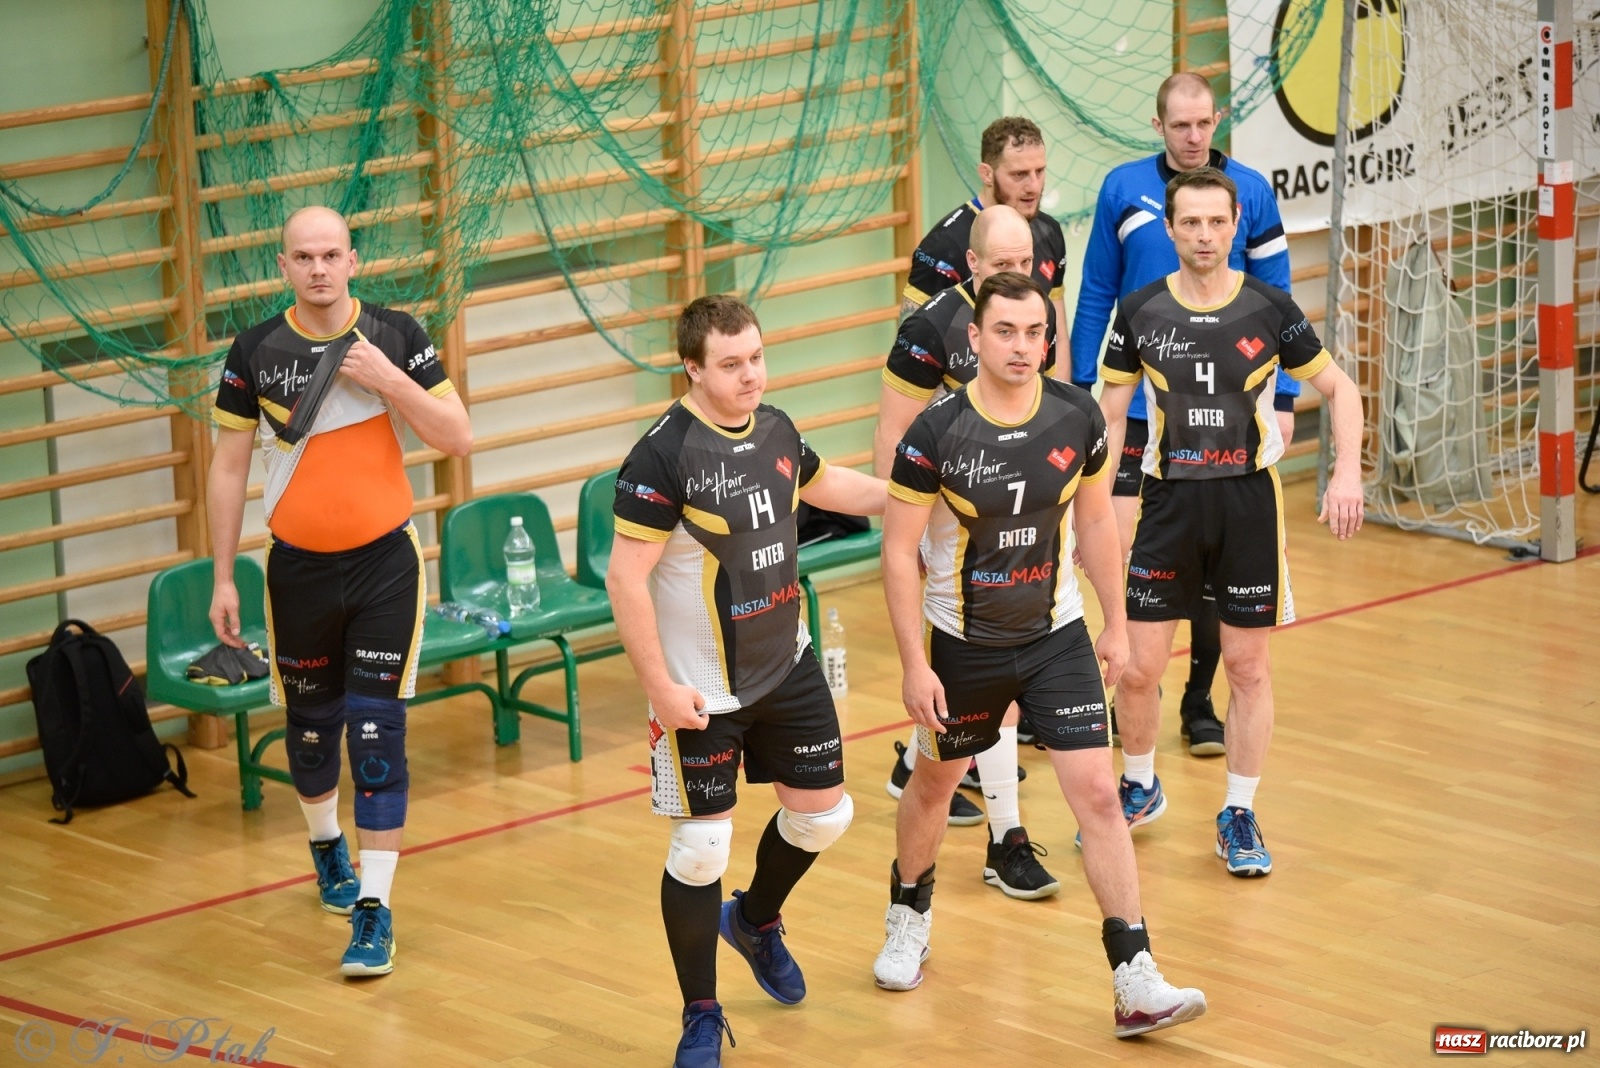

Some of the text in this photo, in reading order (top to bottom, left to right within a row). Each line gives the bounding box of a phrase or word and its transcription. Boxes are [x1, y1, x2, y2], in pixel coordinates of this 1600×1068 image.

[1272, 142, 1416, 200] RACBÓRZ
[1156, 327, 1196, 361] Hair
[1195, 362, 1215, 395] 4
[1188, 408, 1225, 428] ENTER
[1168, 447, 1248, 465] INSTALMAG
[965, 449, 1007, 489] Hair
[982, 476, 998, 485] salon
[711, 461, 746, 505] Hair
[748, 488, 775, 530] 14
[1008, 481, 1026, 515] 7
[999, 527, 1037, 550] ENTER
[752, 542, 785, 571] ENTER
[970, 561, 1053, 587] INSTALMAG
[1227, 584, 1271, 595] GRAVTON
[278, 656, 329, 669] INSTALMAG
[356, 649, 402, 661] GRAVTON
[1055, 702, 1104, 716] GRAVTON
[794, 736, 840, 755] GRAVTON
[682, 749, 734, 767] INSTALMAG
